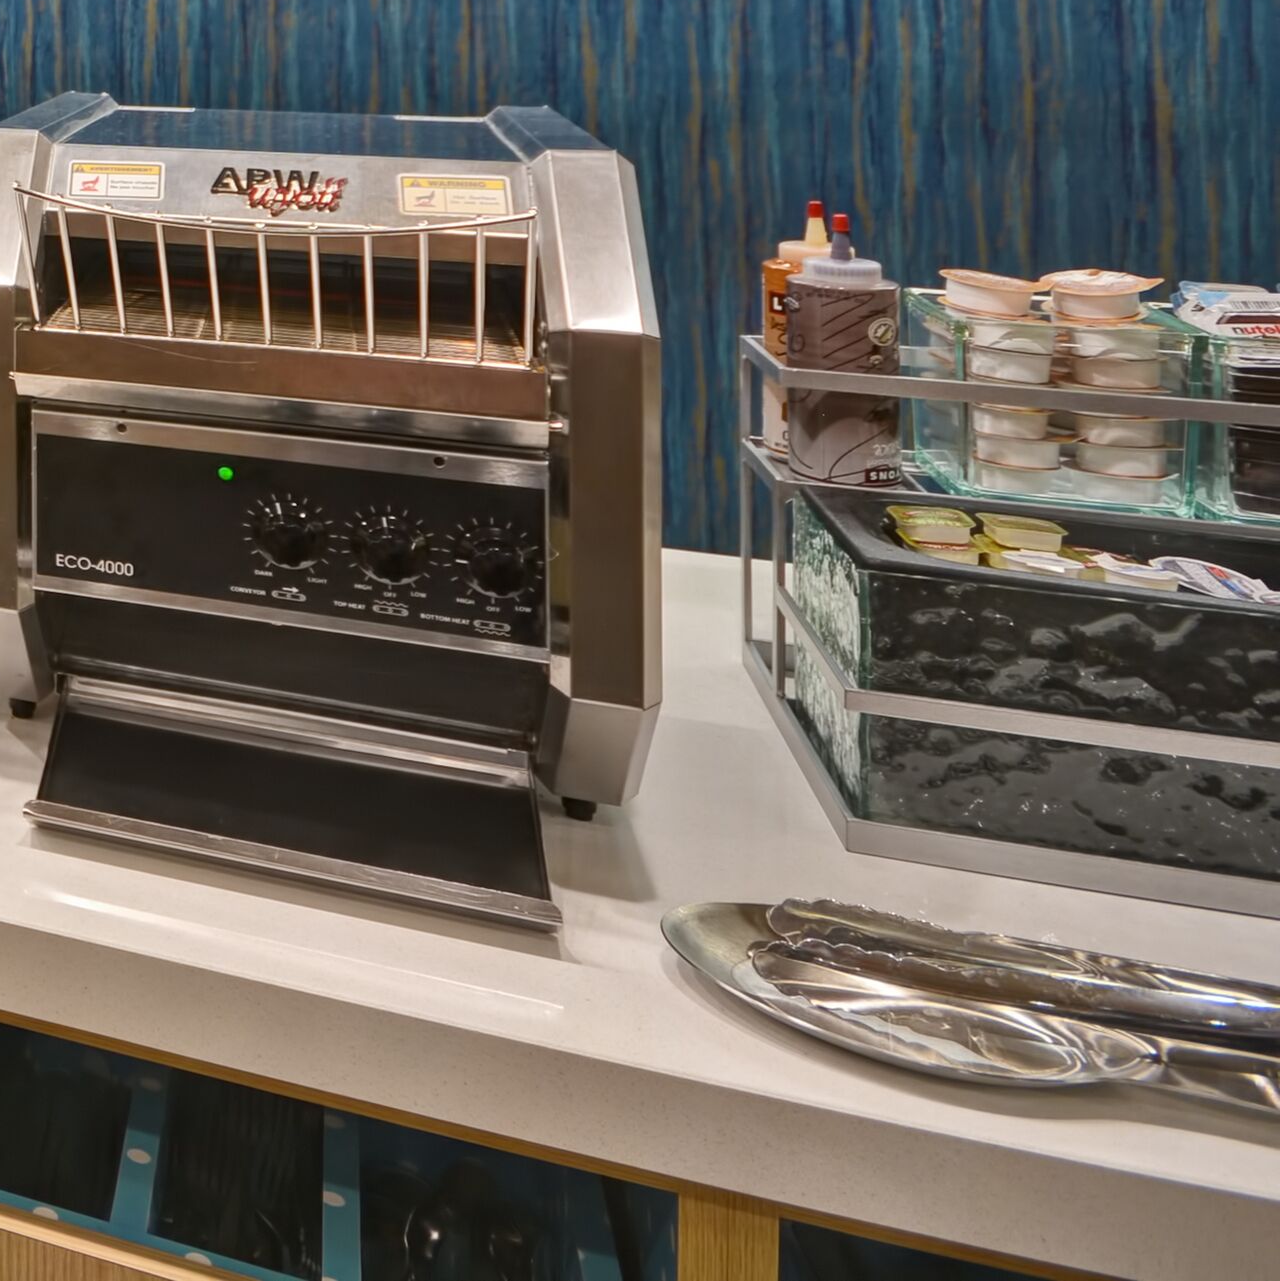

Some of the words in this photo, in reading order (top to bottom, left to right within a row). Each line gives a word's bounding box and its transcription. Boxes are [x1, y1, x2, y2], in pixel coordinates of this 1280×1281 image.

[210, 167, 320, 195] APW
[1231, 323, 1280, 335] nutel
[55, 553, 134, 577] ECO-4000
[254, 569, 273, 577] DARK
[306, 576, 328, 584] LIGHT
[230, 585, 267, 596] CONVEYOR
[353, 583, 373, 591] HIGH
[410, 591, 427, 599] LOW
[333, 600, 349, 608] TOP
[349, 602, 366, 610] HEAT
[456, 597, 476, 605] HIGH
[486, 605, 500, 613] OFF
[515, 605, 533, 613] LOW
[420, 613, 451, 624] BOTTOM
[450, 617, 470, 626] HEAT
